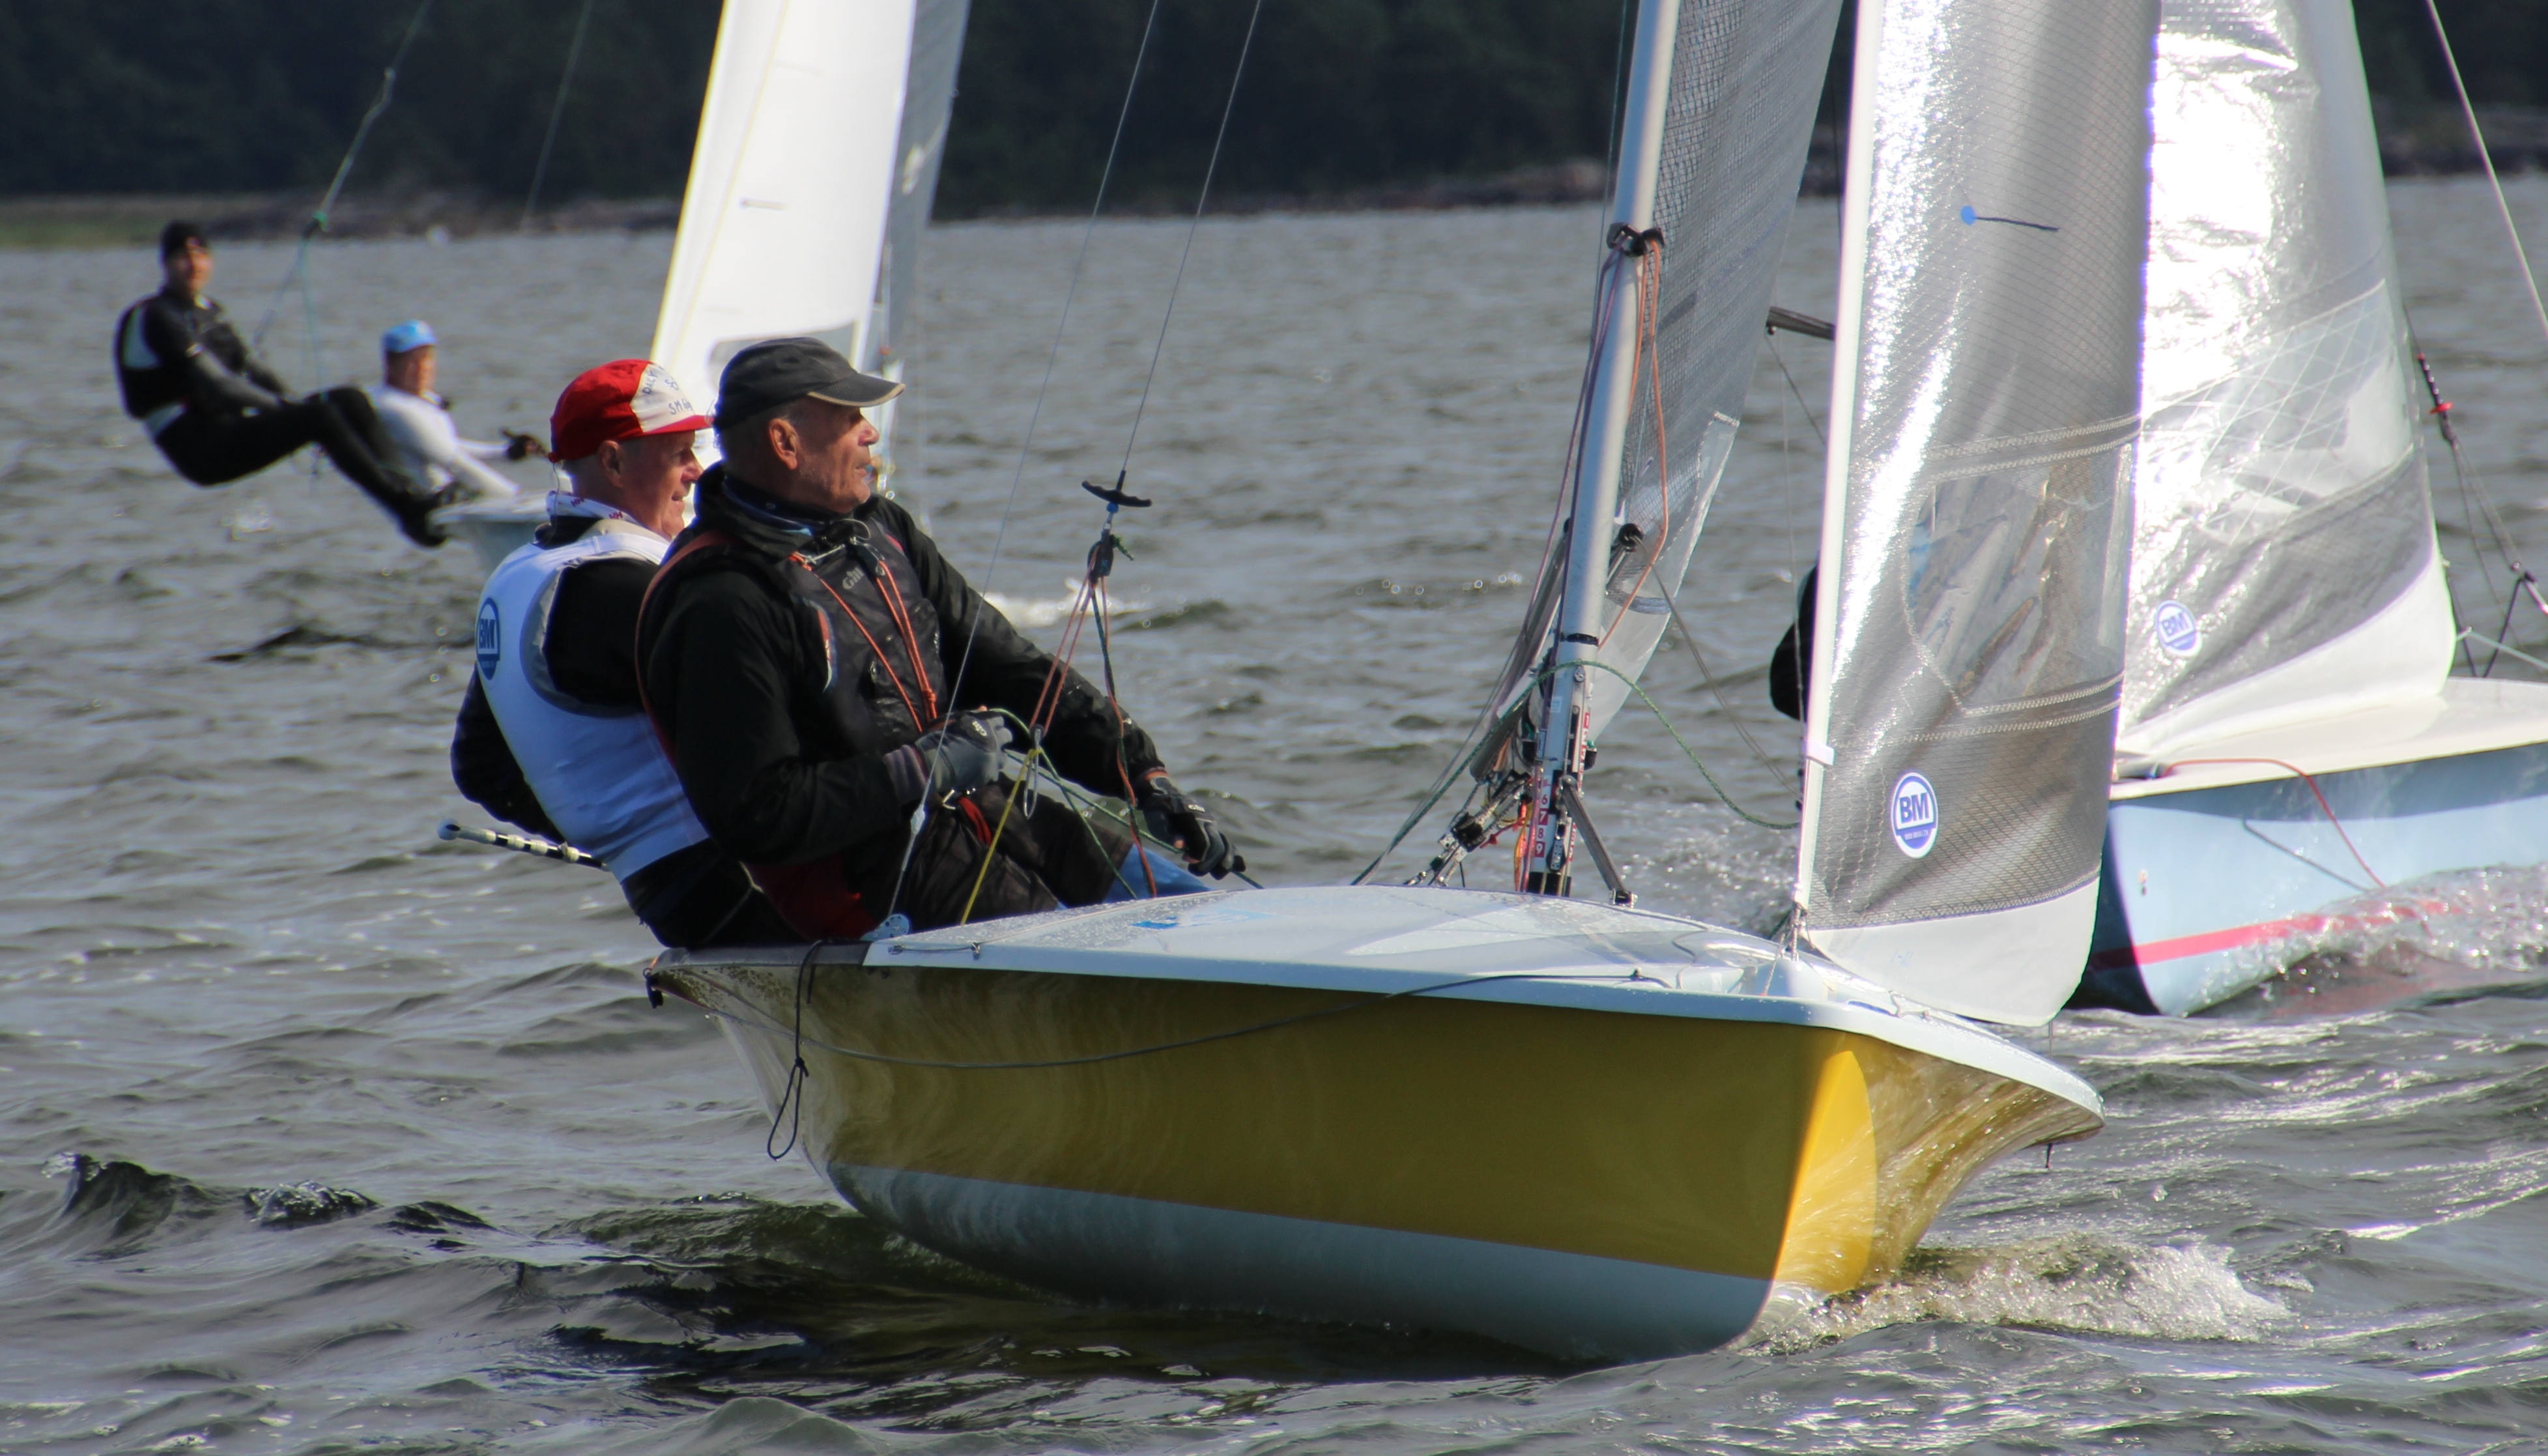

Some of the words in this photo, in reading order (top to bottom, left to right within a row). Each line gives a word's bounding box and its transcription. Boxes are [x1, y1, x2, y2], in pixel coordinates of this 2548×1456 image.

[842, 567, 864, 590] Gill
[2162, 612, 2189, 637] BM
[480, 619, 496, 649] BM
[1541, 794, 1548, 805] 6
[1899, 792, 1930, 824] BM
[1539, 810, 1547, 823] 7
[1538, 827, 1544, 839] 8
[1536, 843, 1543, 854] 9
